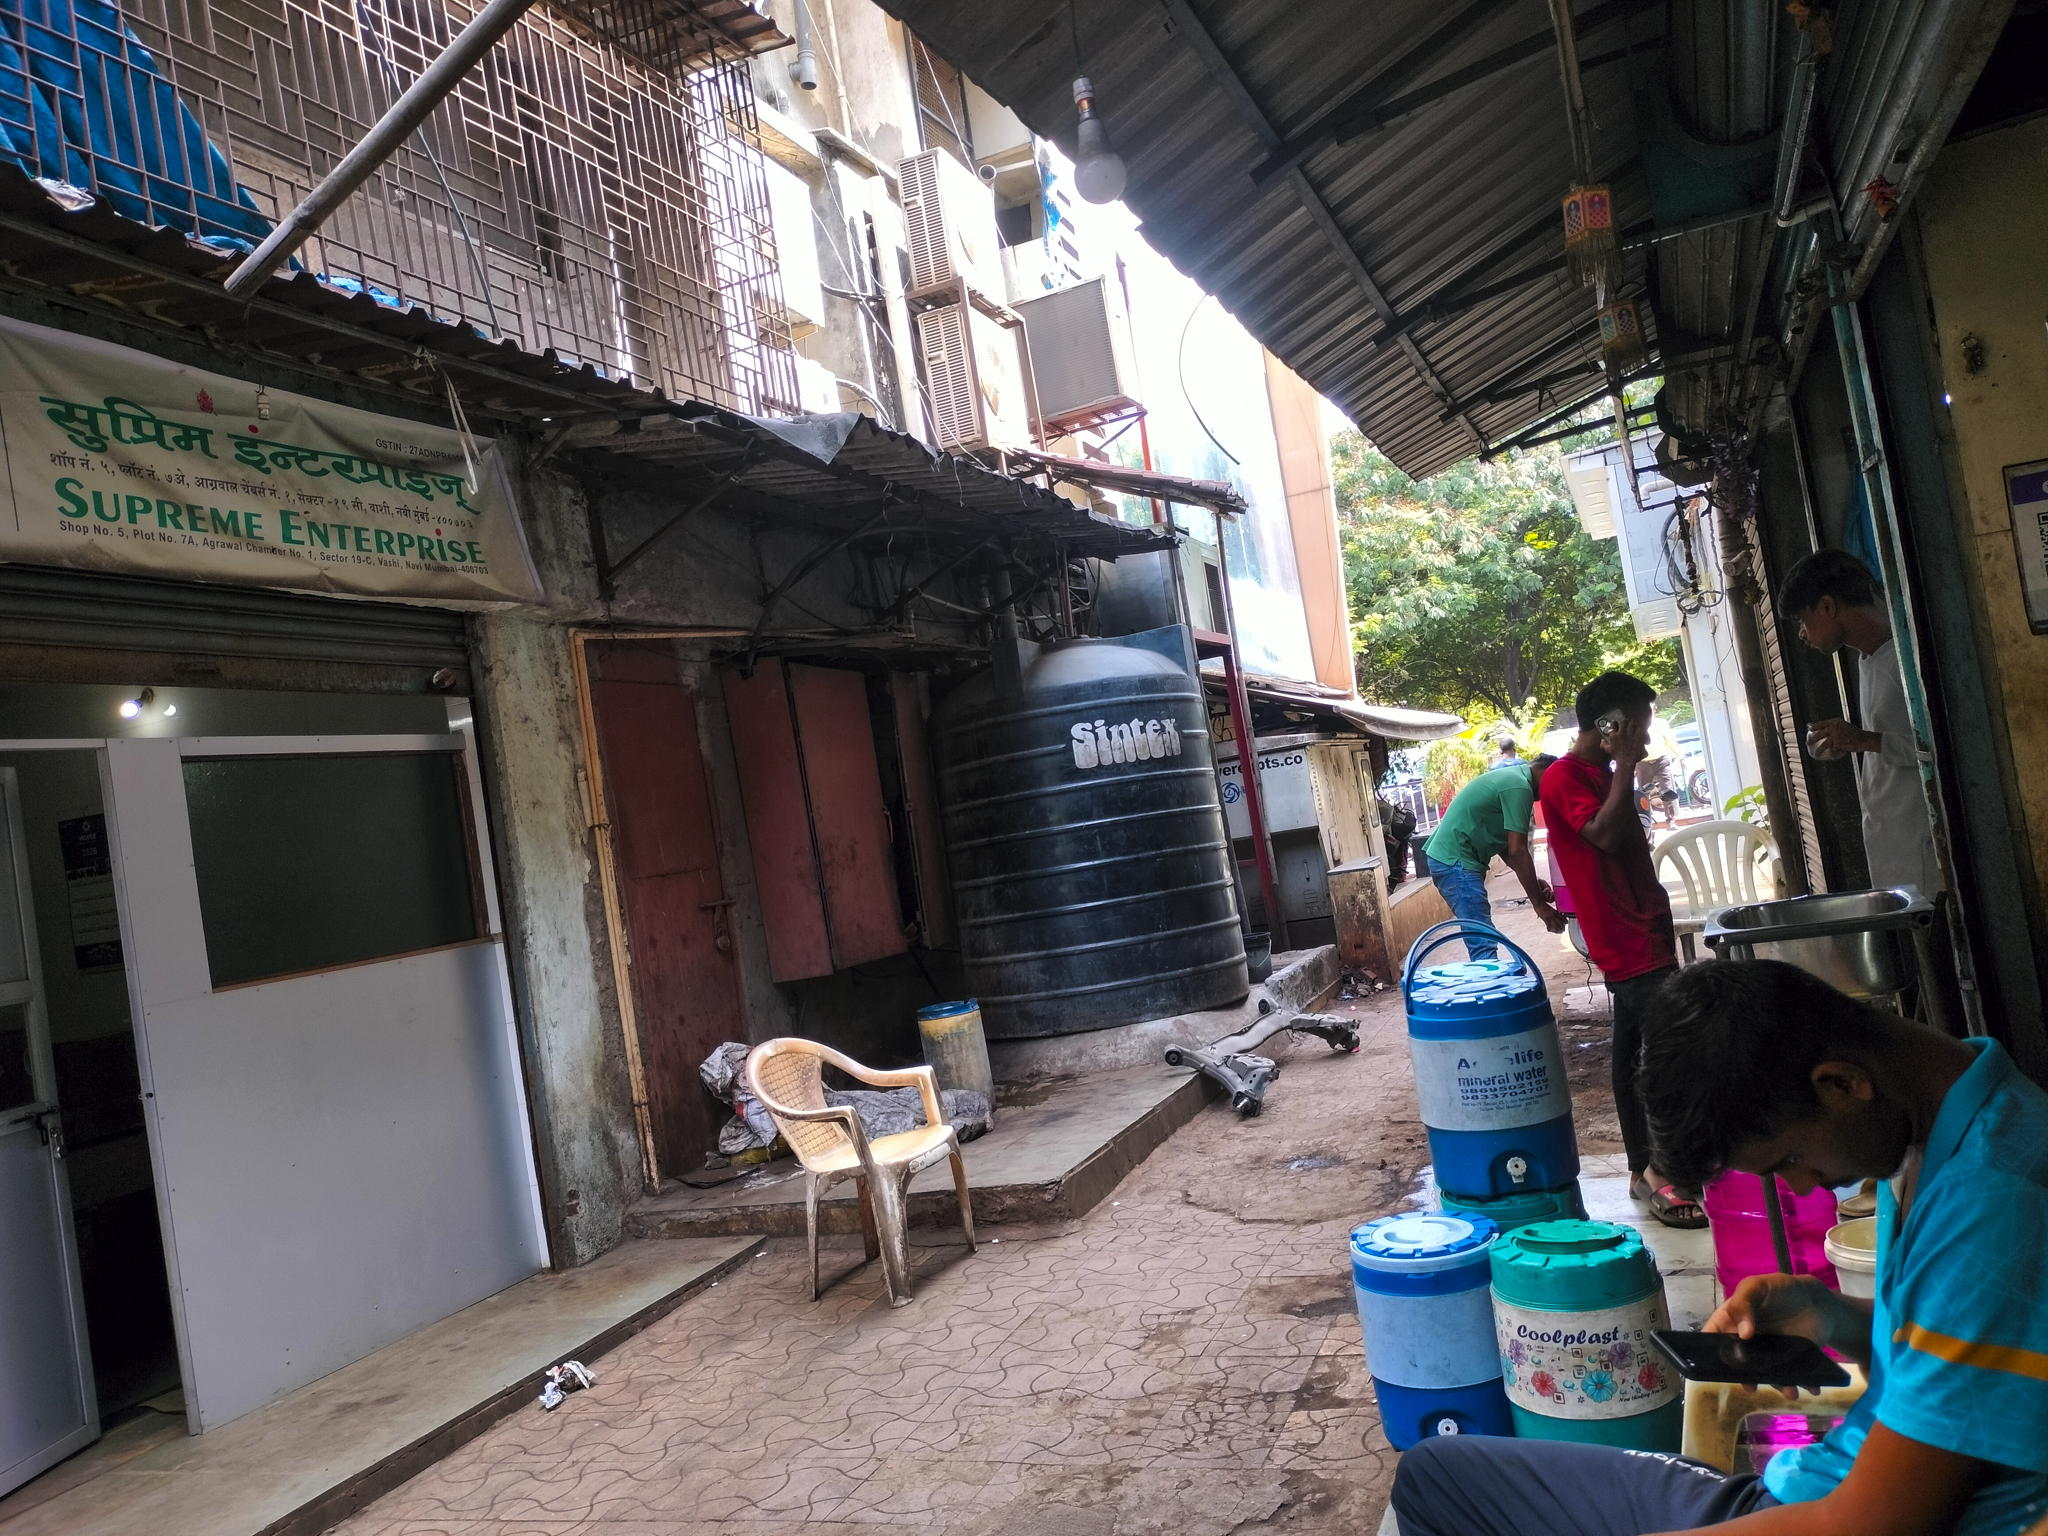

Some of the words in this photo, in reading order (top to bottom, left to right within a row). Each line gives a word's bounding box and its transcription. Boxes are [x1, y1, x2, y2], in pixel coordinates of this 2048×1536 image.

[39, 396, 218, 459] सुप्रिम
[376, 438, 402, 452] GSTIN
[50, 450, 76, 470] शॉप
[79, 453, 95, 471] नं.
[118, 461, 144, 479] प्लॉट
[147, 464, 160, 482] नं.
[194, 476, 238, 494] आग्रवाल
[269, 484, 281, 500] नं.
[298, 488, 325, 507] सेक्टर
[368, 501, 394, 518] वाशी,
[396, 504, 411, 520] नवी
[412, 504, 430, 523] मुंबई
[54, 476, 265, 541] SUPREME
[279, 509, 485, 564] ENTERPRISE
[60, 520, 89, 536] Shop
[93, 524, 113, 537] No.
[117, 527, 129, 540] 5,
[133, 529, 156, 542] Plot
[158, 532, 177, 544] No.
[180, 535, 199, 548] 7A,
[202, 537, 243, 552] Agrawal
[246, 542, 287, 557] Chamber
[289, 547, 306, 559] No.
[320, 551, 348, 563] Sector
[377, 557, 404, 569] Vashi,
[405, 560, 422, 571] Navi
[1071, 718, 1181, 769] Sintex
[1458, 1072, 1510, 1087] mineral
[1513, 1065, 1547, 1083] water
[1517, 1325, 1619, 1347] Coolplast
